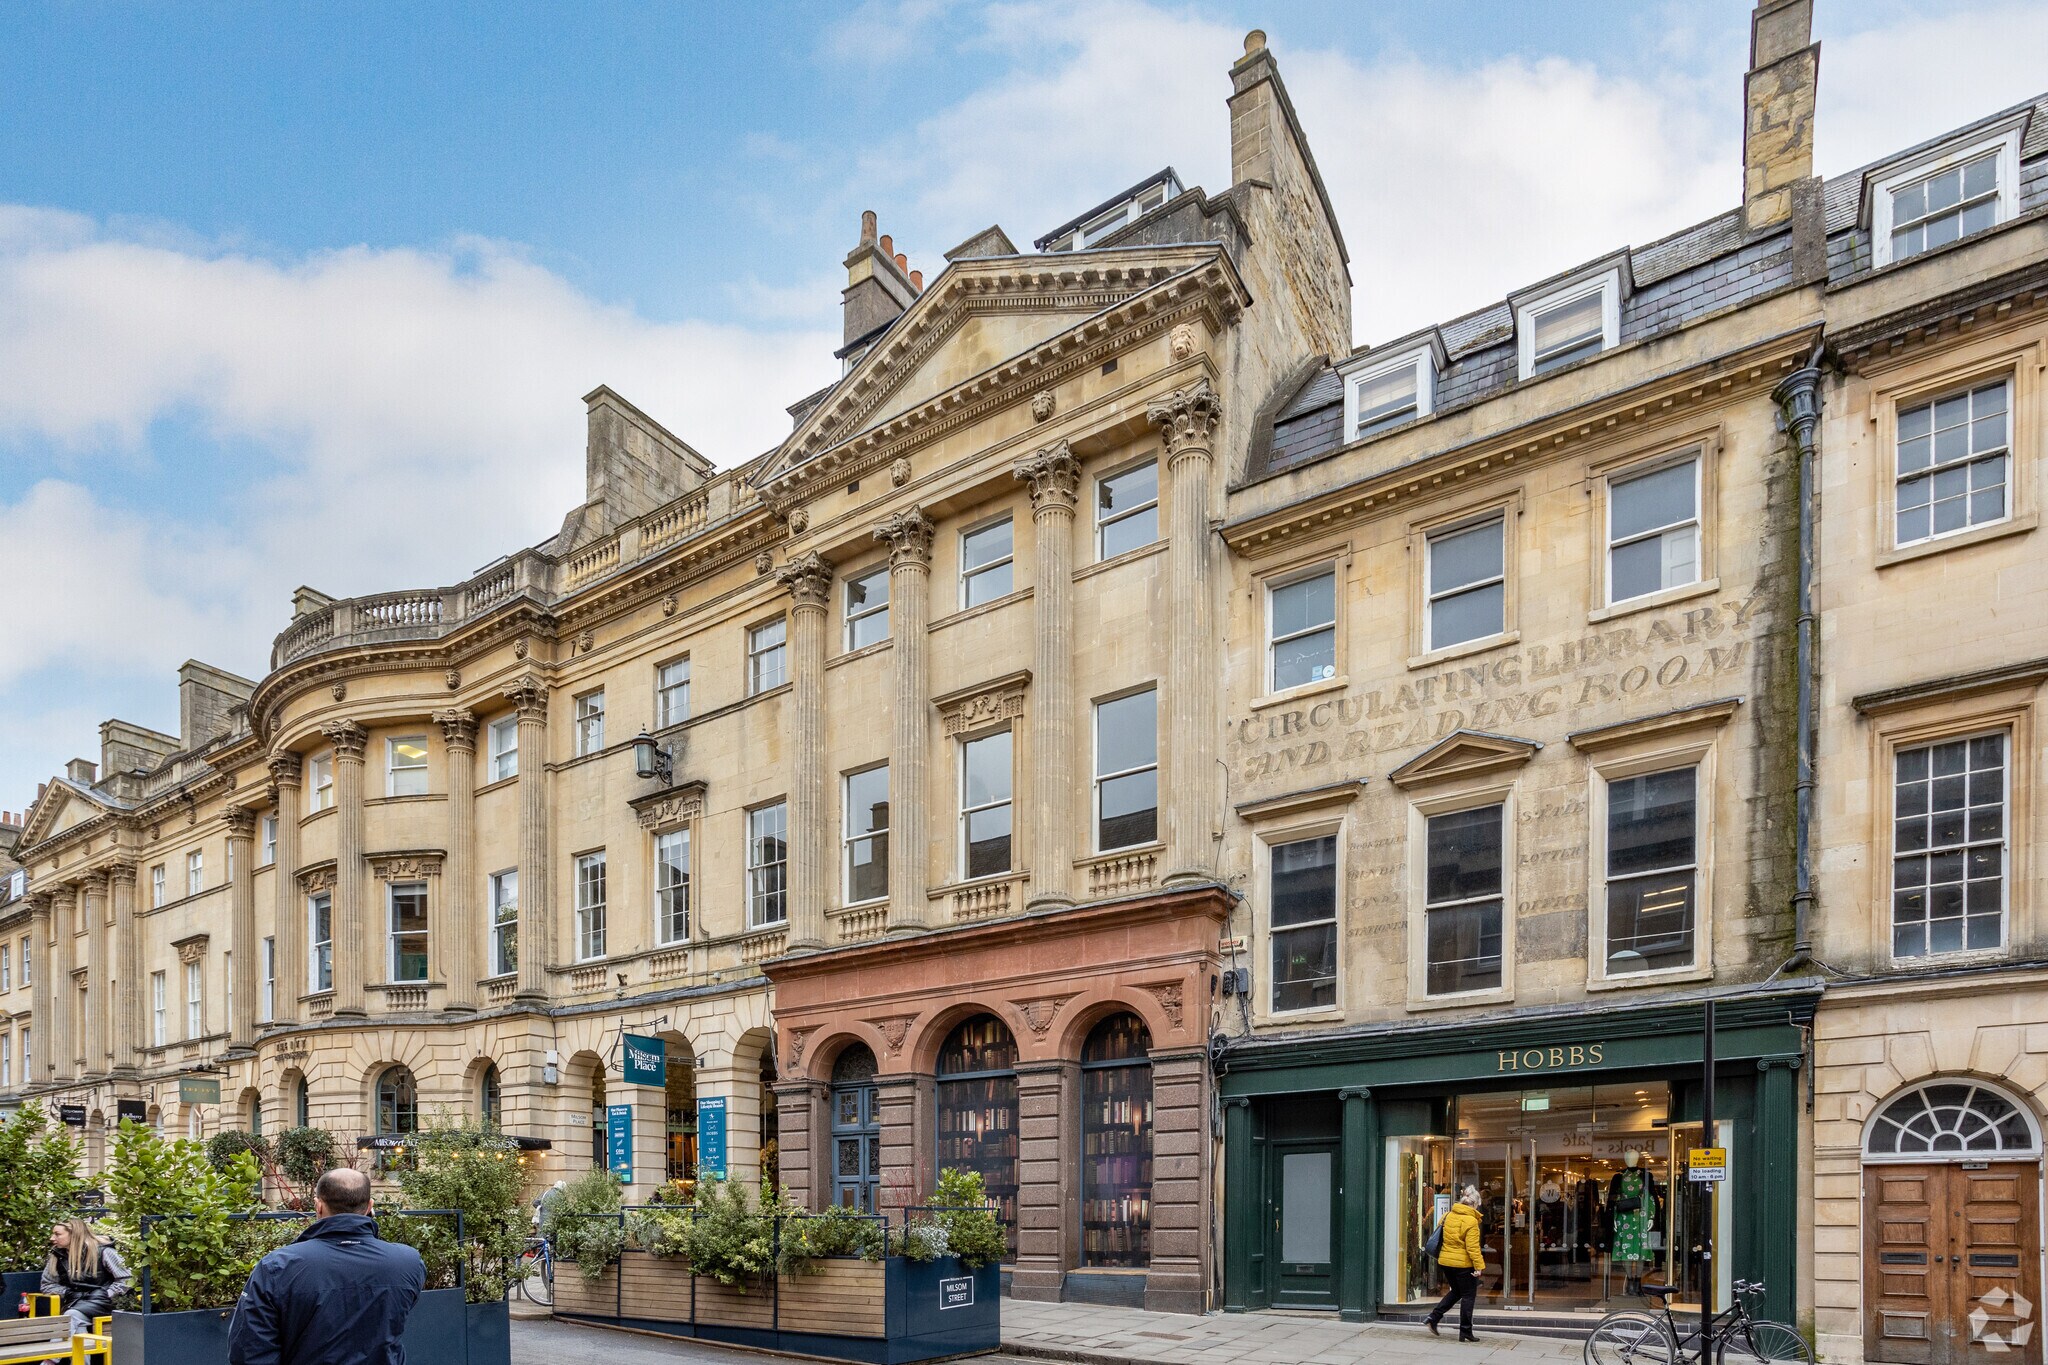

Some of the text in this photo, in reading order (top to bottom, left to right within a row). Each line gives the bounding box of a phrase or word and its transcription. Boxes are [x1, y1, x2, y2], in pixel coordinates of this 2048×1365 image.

[1237, 596, 1762, 746] CIRCULATING LIBRARY
[1246, 641, 1752, 781] AND READING ROOM
[628, 1048, 660, 1063] Milsom
[1497, 1044, 1603, 1071] HOBBS
[634, 1059, 657, 1072] Place
[947, 1283, 967, 1292] MILSOM
[949, 1293, 966, 1302] STREET
